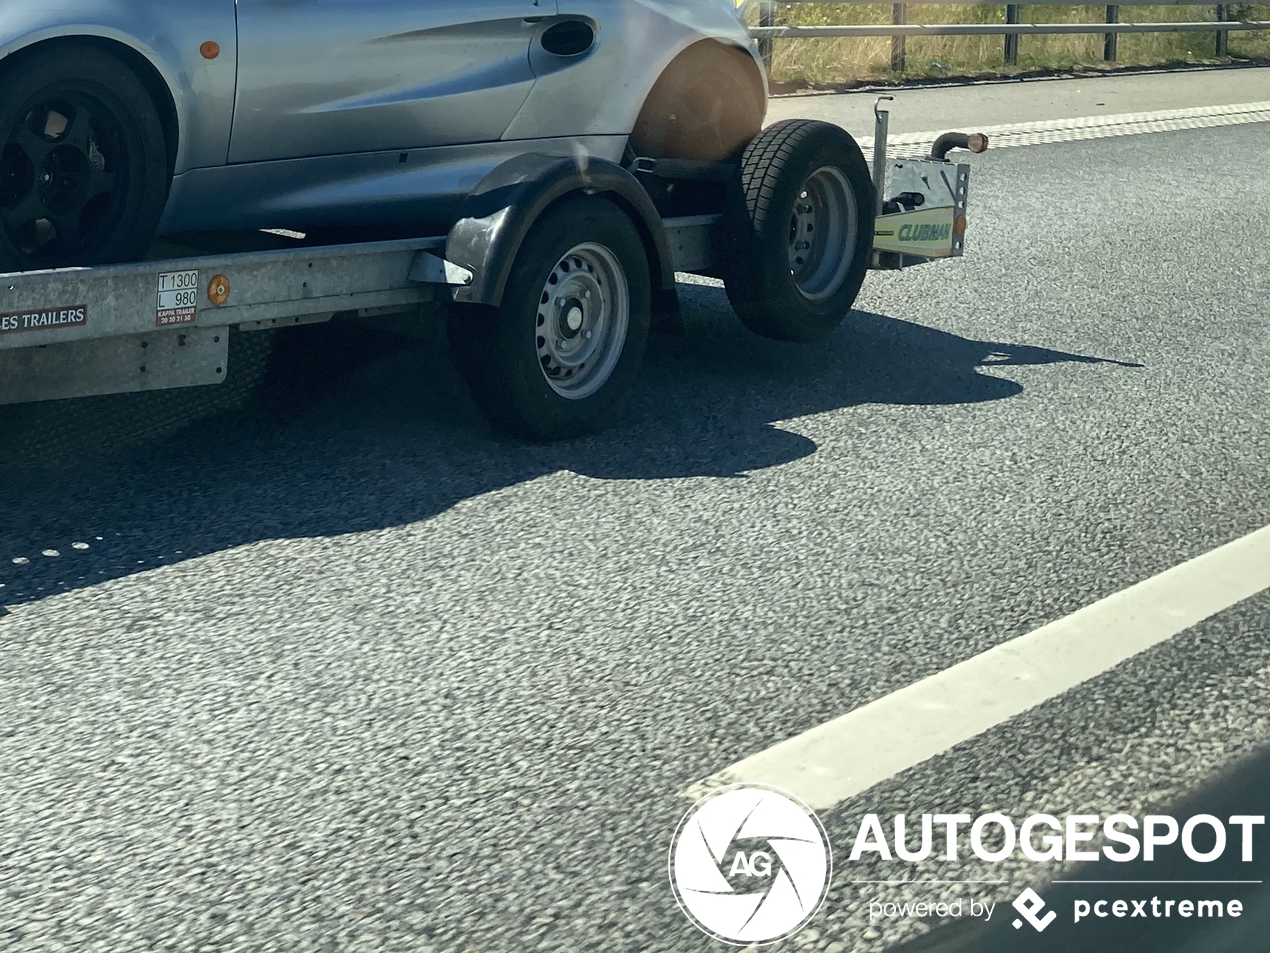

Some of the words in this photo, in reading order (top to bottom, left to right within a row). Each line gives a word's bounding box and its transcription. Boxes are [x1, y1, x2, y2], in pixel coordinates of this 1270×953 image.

[160, 275, 168, 289] T
[171, 273, 197, 288] 1300
[159, 294, 165, 308] L
[175, 291, 196, 306] 980
[22, 308, 84, 328] TRAILERS
[158, 310, 175, 318] KAPPA
